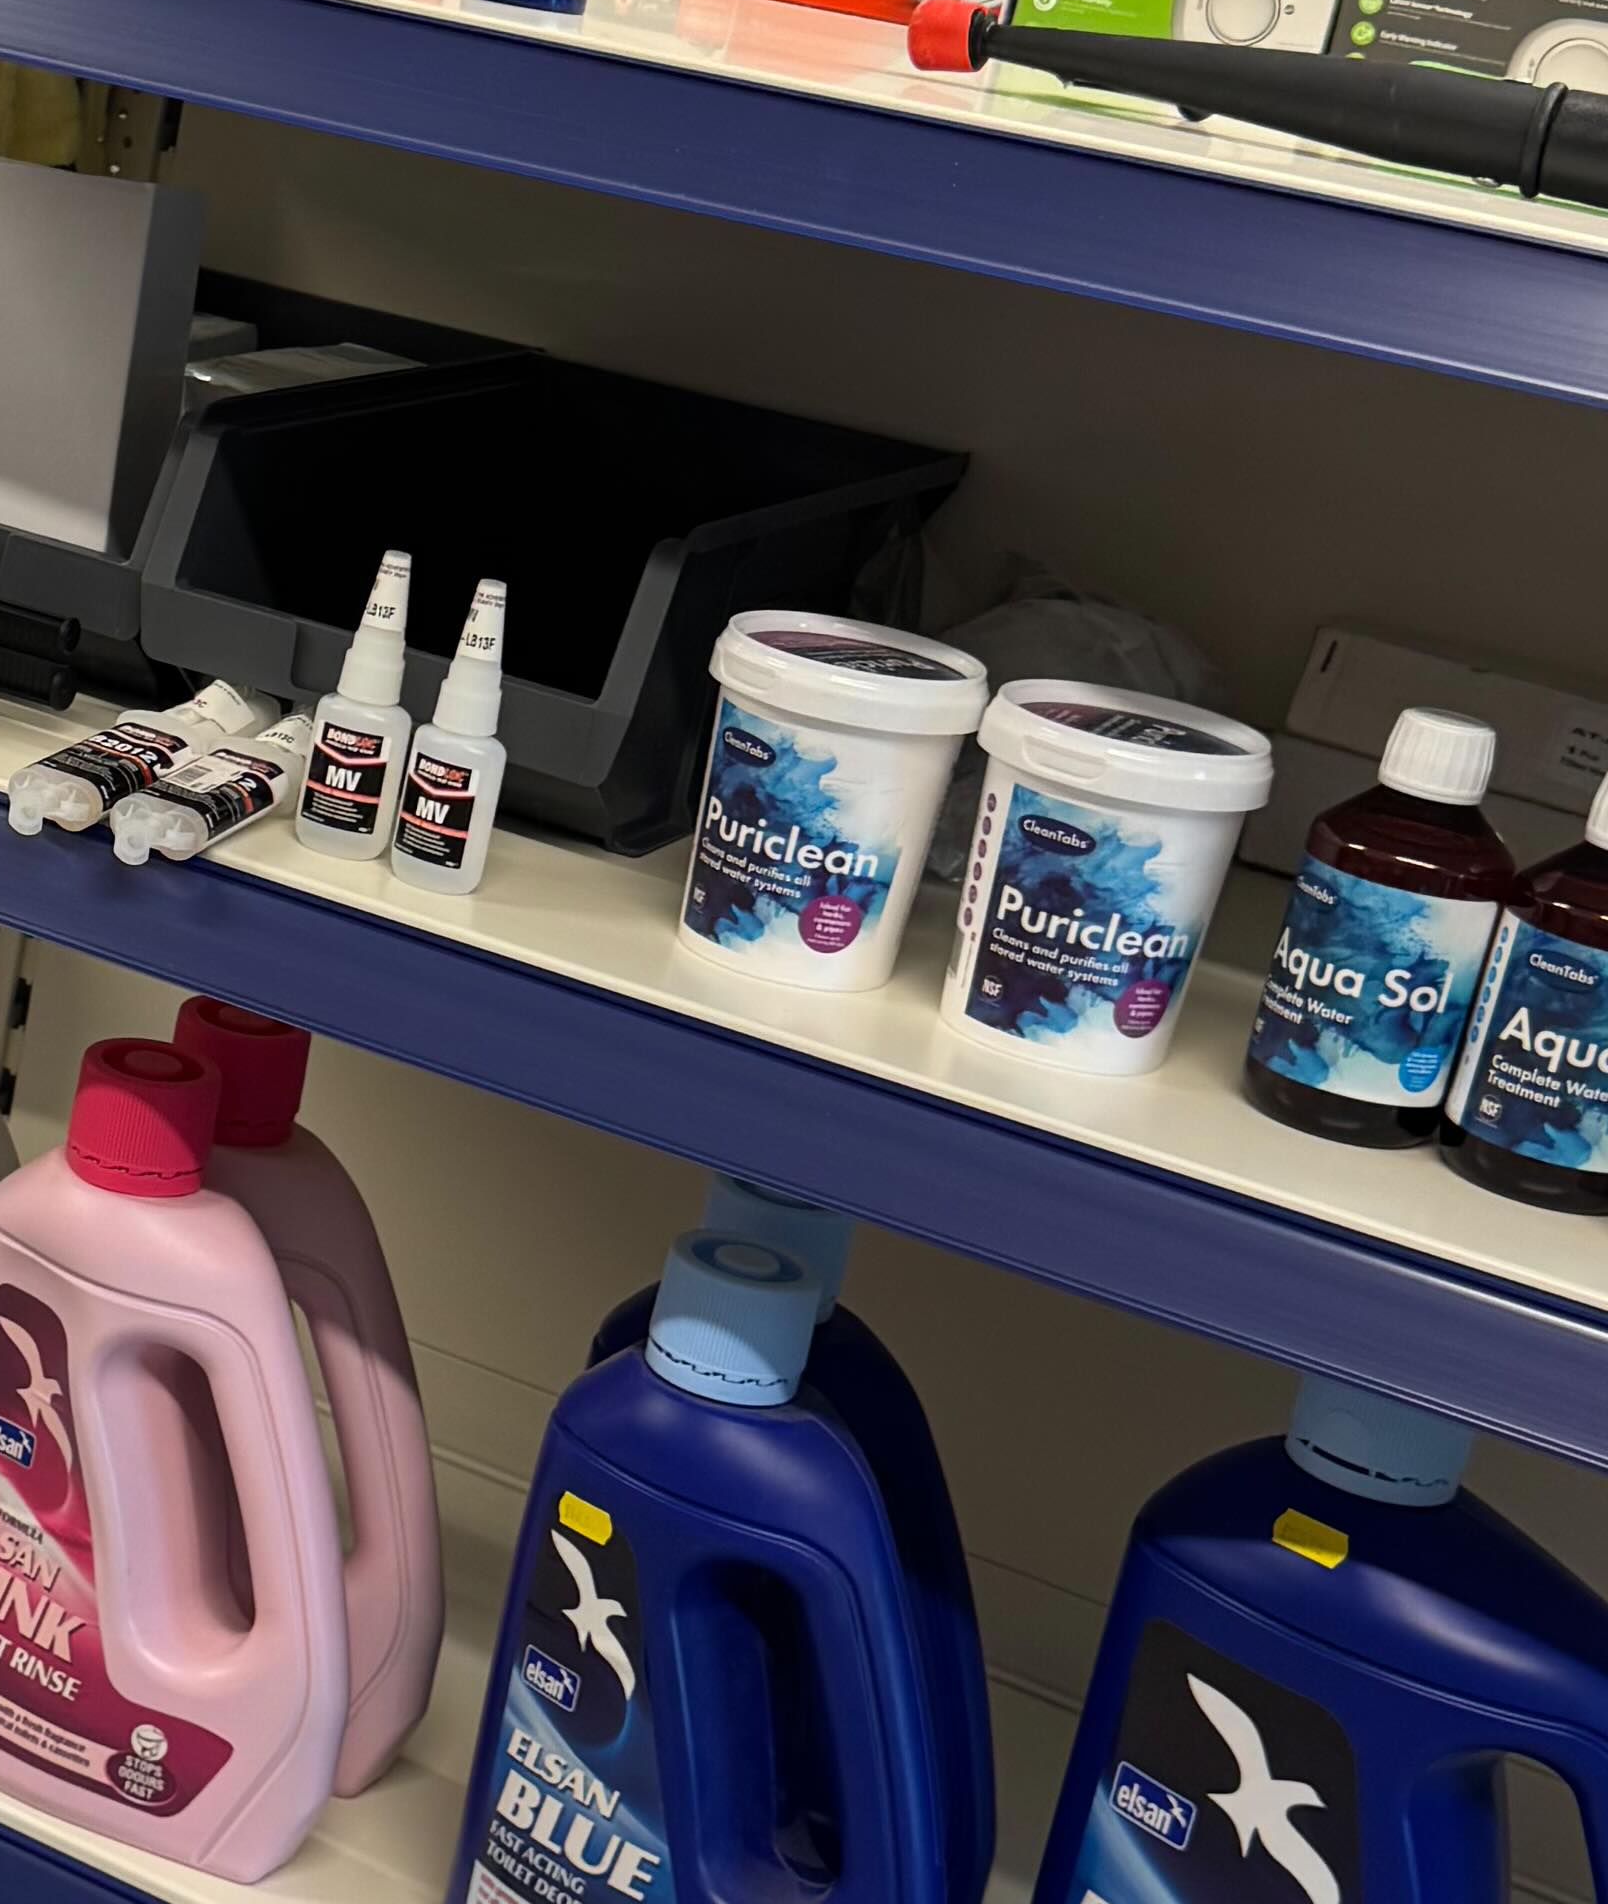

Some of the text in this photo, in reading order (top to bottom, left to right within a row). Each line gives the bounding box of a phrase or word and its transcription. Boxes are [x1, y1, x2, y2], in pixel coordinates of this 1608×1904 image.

[325, 766, 362, 792] MV
[416, 797, 450, 824] MV
[1023, 817, 1087, 849] CleanTabs
[705, 796, 879, 878] Puriclean
[996, 883, 1189, 959] Puriclean
[989, 942, 1119, 987] stored water systems
[992, 927, 1129, 974] Cleans and purifies all
[1274, 926, 1454, 1014] Aqua Sol
[1529, 952, 1596, 986] CleanTabs
[1487, 1068, 1561, 1108] Treatment
[1491, 1053, 1608, 1103] Complete Wate
[9, 1646, 82, 1702] RINSE
[525, 1659, 564, 1702] elsan
[118, 1768, 165, 1793] ODOURS
[124, 1755, 163, 1778] STOPS
[506, 1727, 620, 1819] ELSAN
[124, 1781, 155, 1800] FAST
[1116, 1782, 1172, 1837] elsan
[490, 1819, 587, 1896] FAST ACTING
[495, 1769, 661, 1902] BLUE
[487, 1840, 536, 1888] TOILET
